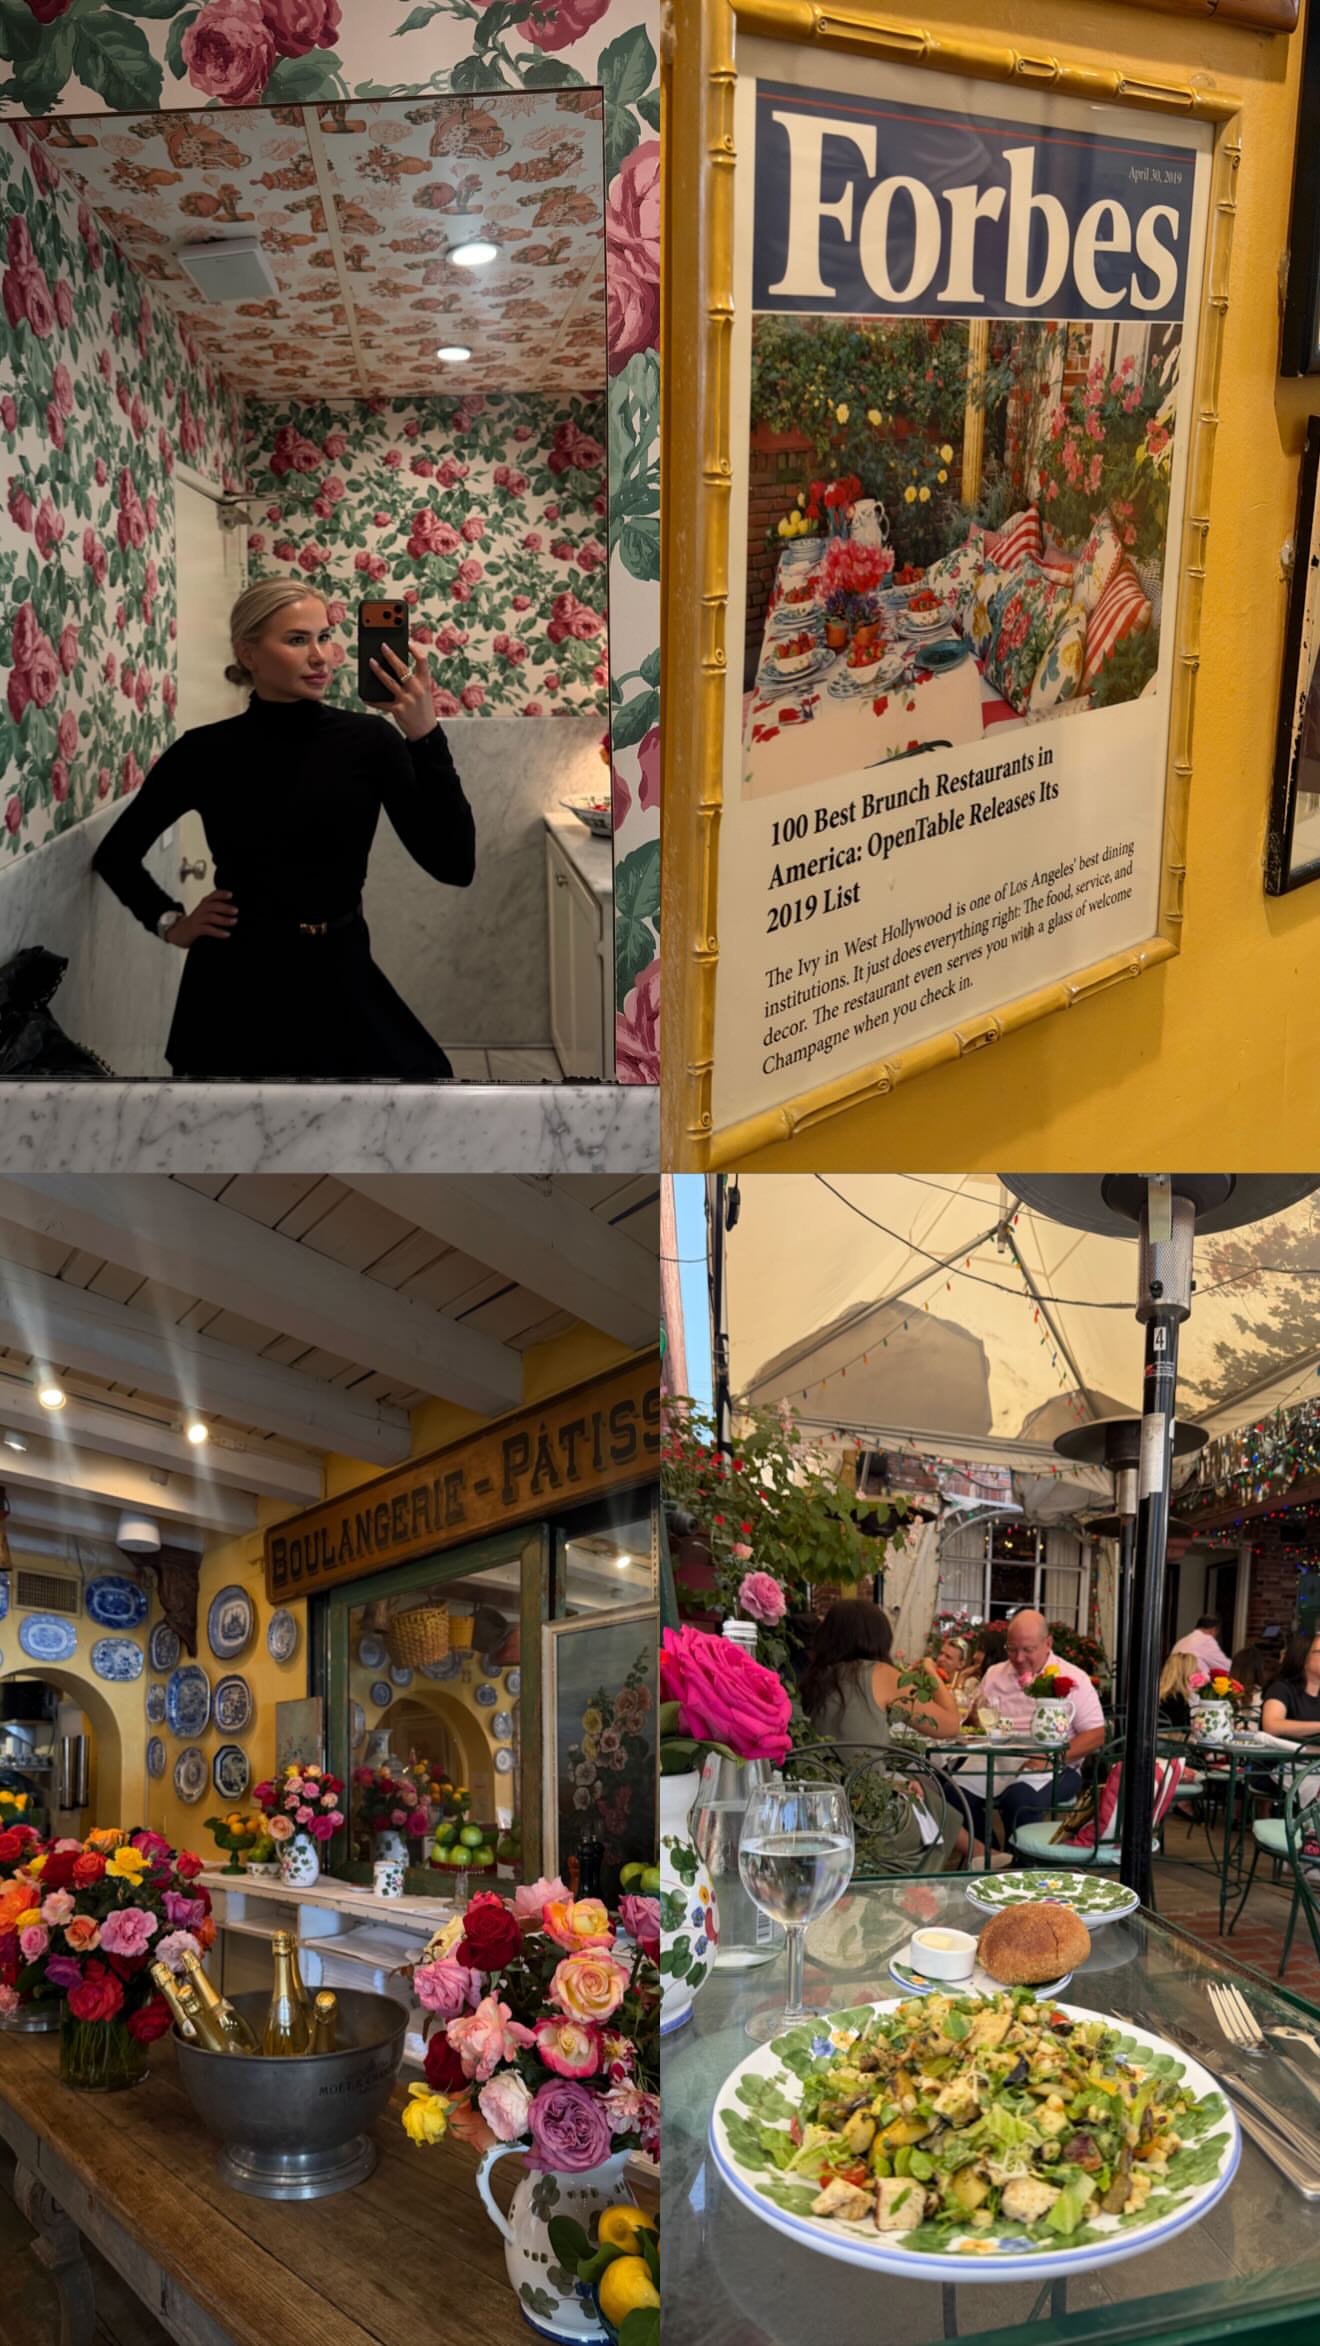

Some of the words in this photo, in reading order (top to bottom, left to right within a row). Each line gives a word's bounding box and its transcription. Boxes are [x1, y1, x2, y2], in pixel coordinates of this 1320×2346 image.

[768, 109, 1180, 311] Forbes
[1129, 166, 1150, 184] April
[1163, 170, 1183, 185] 2019
[768, 845, 862, 890] America:
[867, 808, 965, 860] OpenTable
[969, 789, 1036, 826] Releases
[1039, 780, 1060, 803] Its
[771, 814, 808, 847] 100
[813, 801, 856, 834] Best
[861, 778, 930, 819] Brunch
[935, 753, 1035, 798] Restaurants
[1038, 746, 1054, 768] in
[764, 974, 850, 1018] institutions.
[853, 964, 864, 983] It
[865, 956, 890, 984] just
[892, 946, 922, 966] does
[923, 918, 989, 954] everything
[991, 906, 1021, 929] right:
[1024, 896, 1044, 914] The
[1046, 883, 1073, 907] food,
[1075, 872, 1113, 895] service,
[1114, 860, 1134, 880] and
[765, 967, 793, 989] The
[797, 956, 821, 977] Ivy
[825, 949, 839, 966] in
[844, 933, 878, 958] West
[881, 904, 953, 945] Hollywood
[956, 901, 966, 917] is
[969, 893, 991, 912] one
[994, 882, 1009, 902] of
[1009, 879, 1028, 897] Los
[1079, 852, 1100, 871] best
[1102, 841, 1135, 863] dining
[766, 894, 818, 934] 2019
[822, 881, 861, 914] List
[763, 1019, 808, 1047] decor.
[813, 1003, 840, 1026] The
[843, 974, 911, 1014] restaurant
[913, 963, 943, 984] even
[946, 946, 983, 971] serves
[986, 936, 1008, 960] you
[1011, 922, 1036, 944] with
[1038, 922, 1045, 934] a
[1048, 910, 1073, 934] glass
[1075, 900, 1088, 918] of
[1088, 887, 1133, 913] welcome
[762, 1028, 850, 1075] Champagne
[853, 1010, 889, 1036] when
[892, 1000, 917, 1024] you
[920, 980, 957, 1008] check
[959, 976, 974, 993] in.
[1155, 1328, 1165, 1349] 4
[271, 1469, 467, 1588] BOULANGERIE
